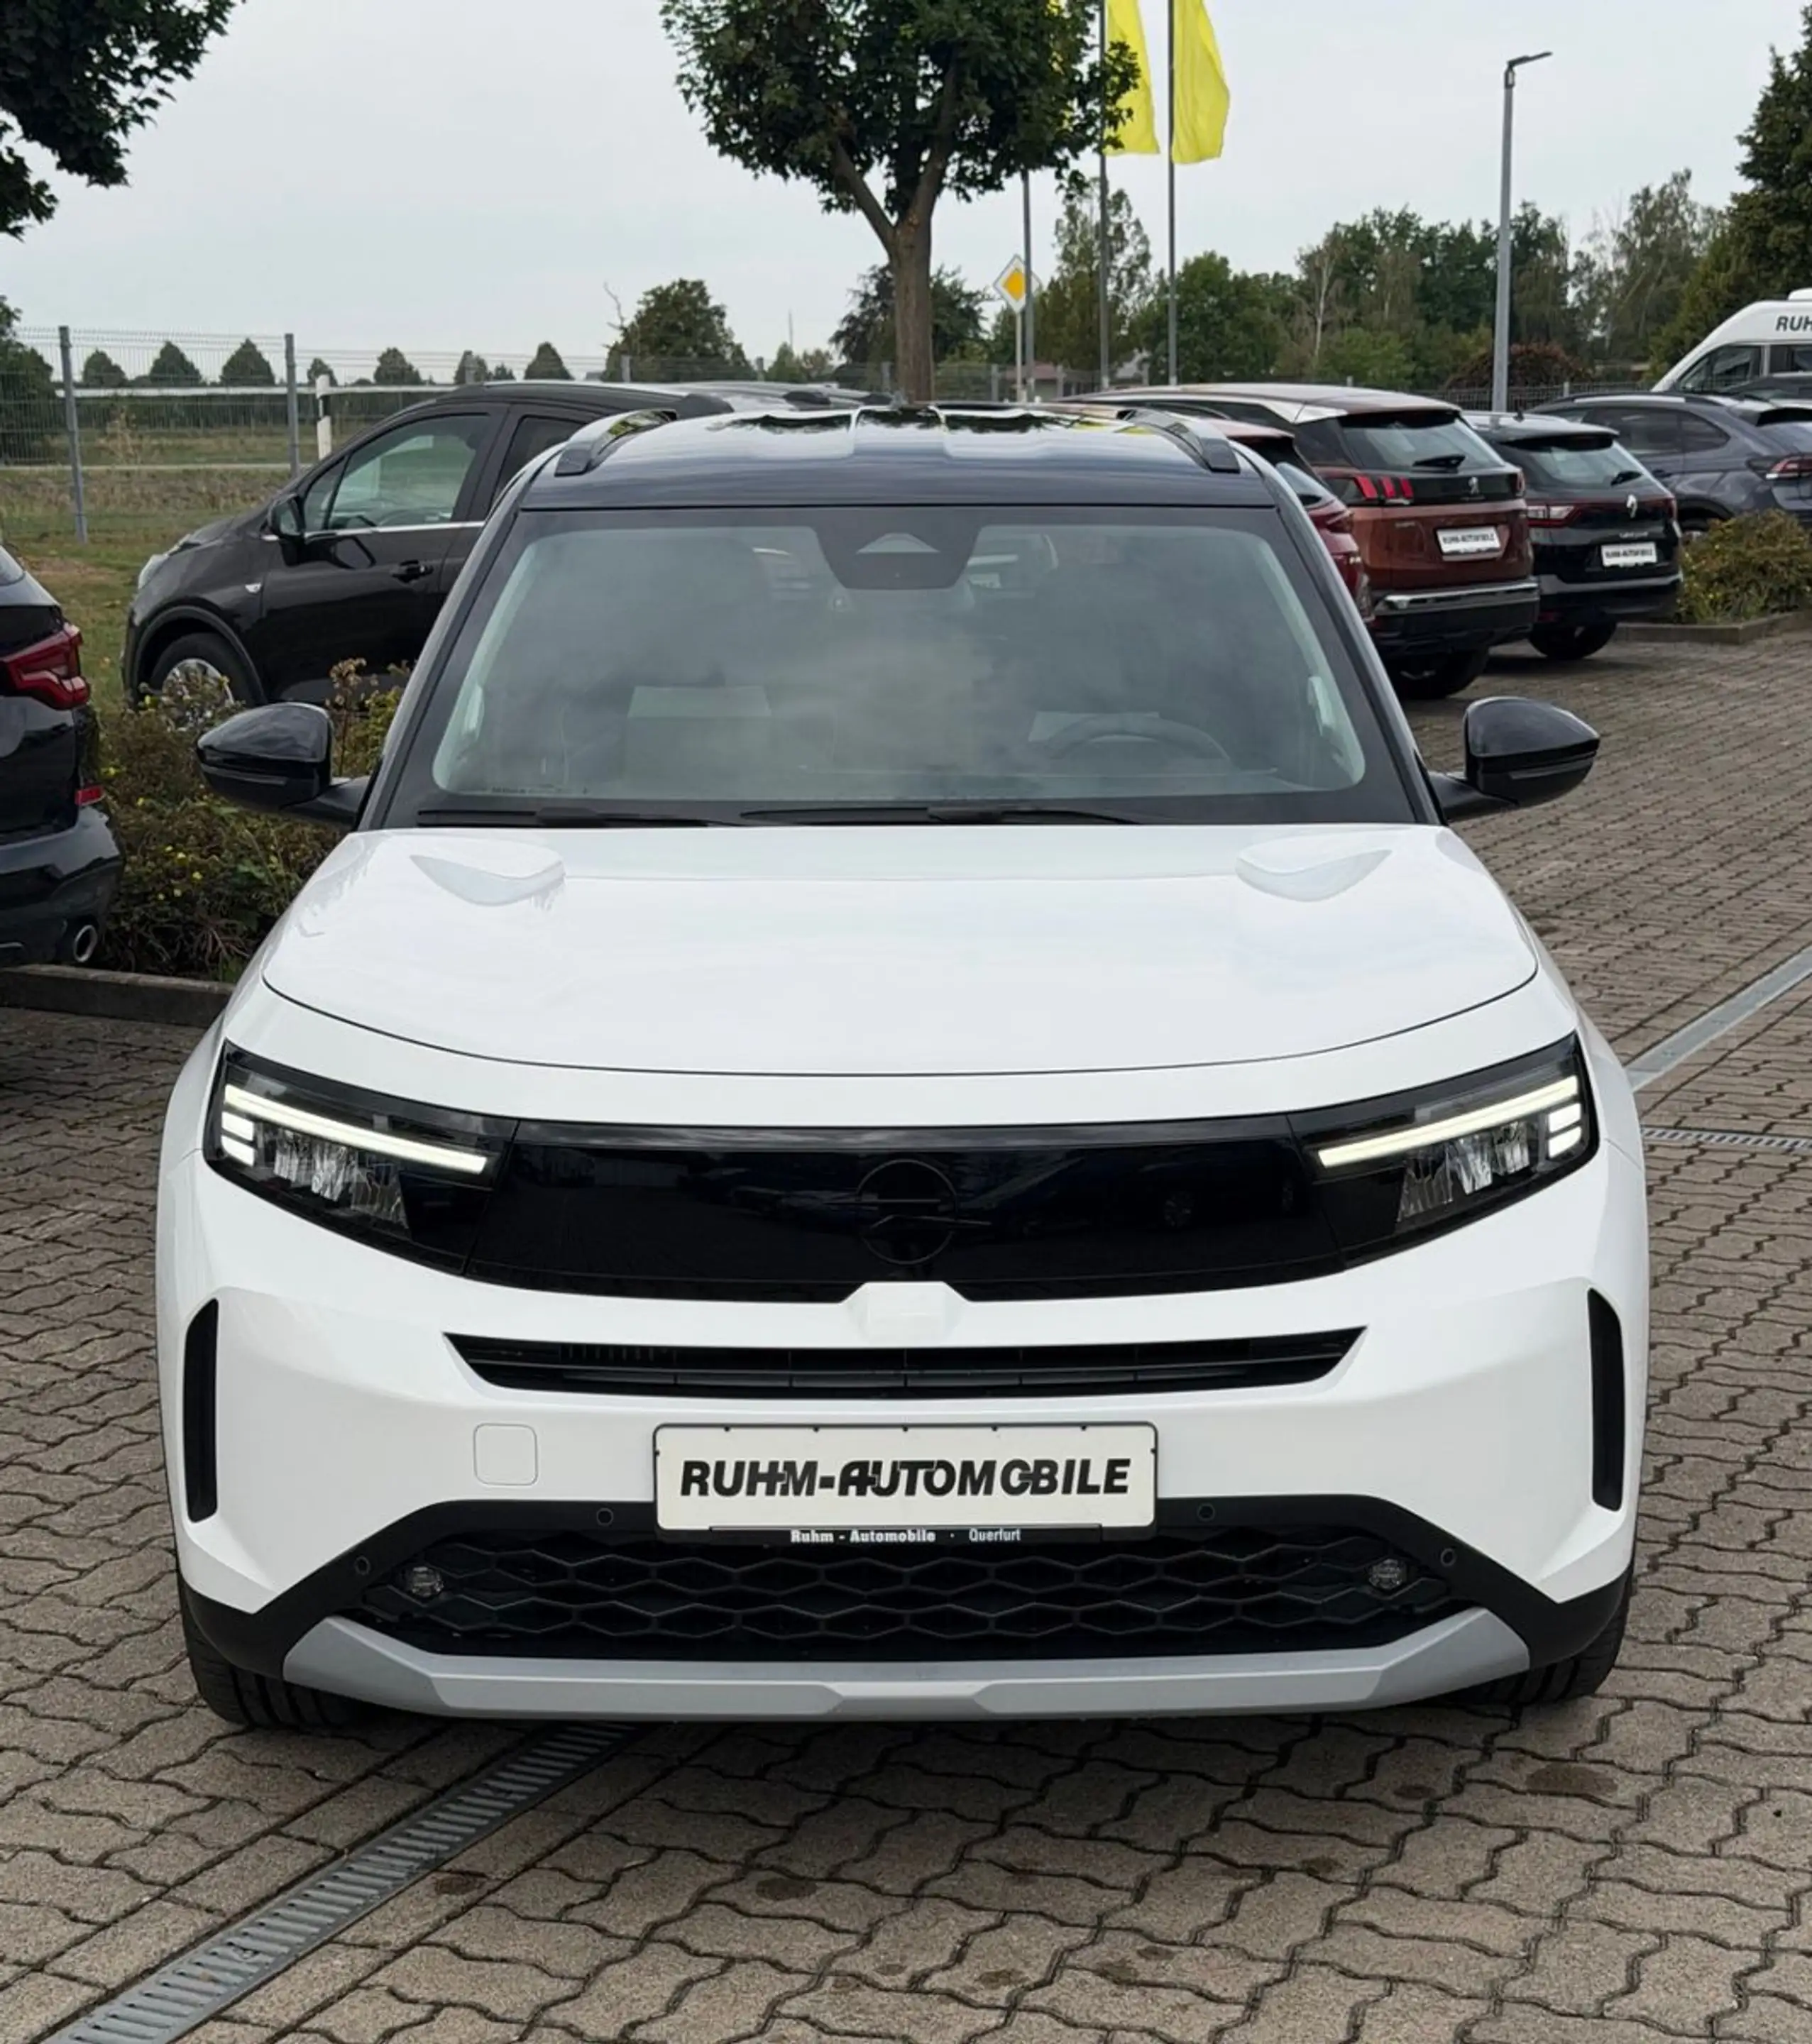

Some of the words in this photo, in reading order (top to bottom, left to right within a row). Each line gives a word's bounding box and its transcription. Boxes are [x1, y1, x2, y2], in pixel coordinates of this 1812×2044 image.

[681, 1458, 1131, 1497] RUHM-AUTOMOBILE
[791, 1529, 834, 1543] Ruhm
[850, 1528, 936, 1543] Automobile
[969, 1527, 1021, 1542] Querfurt
